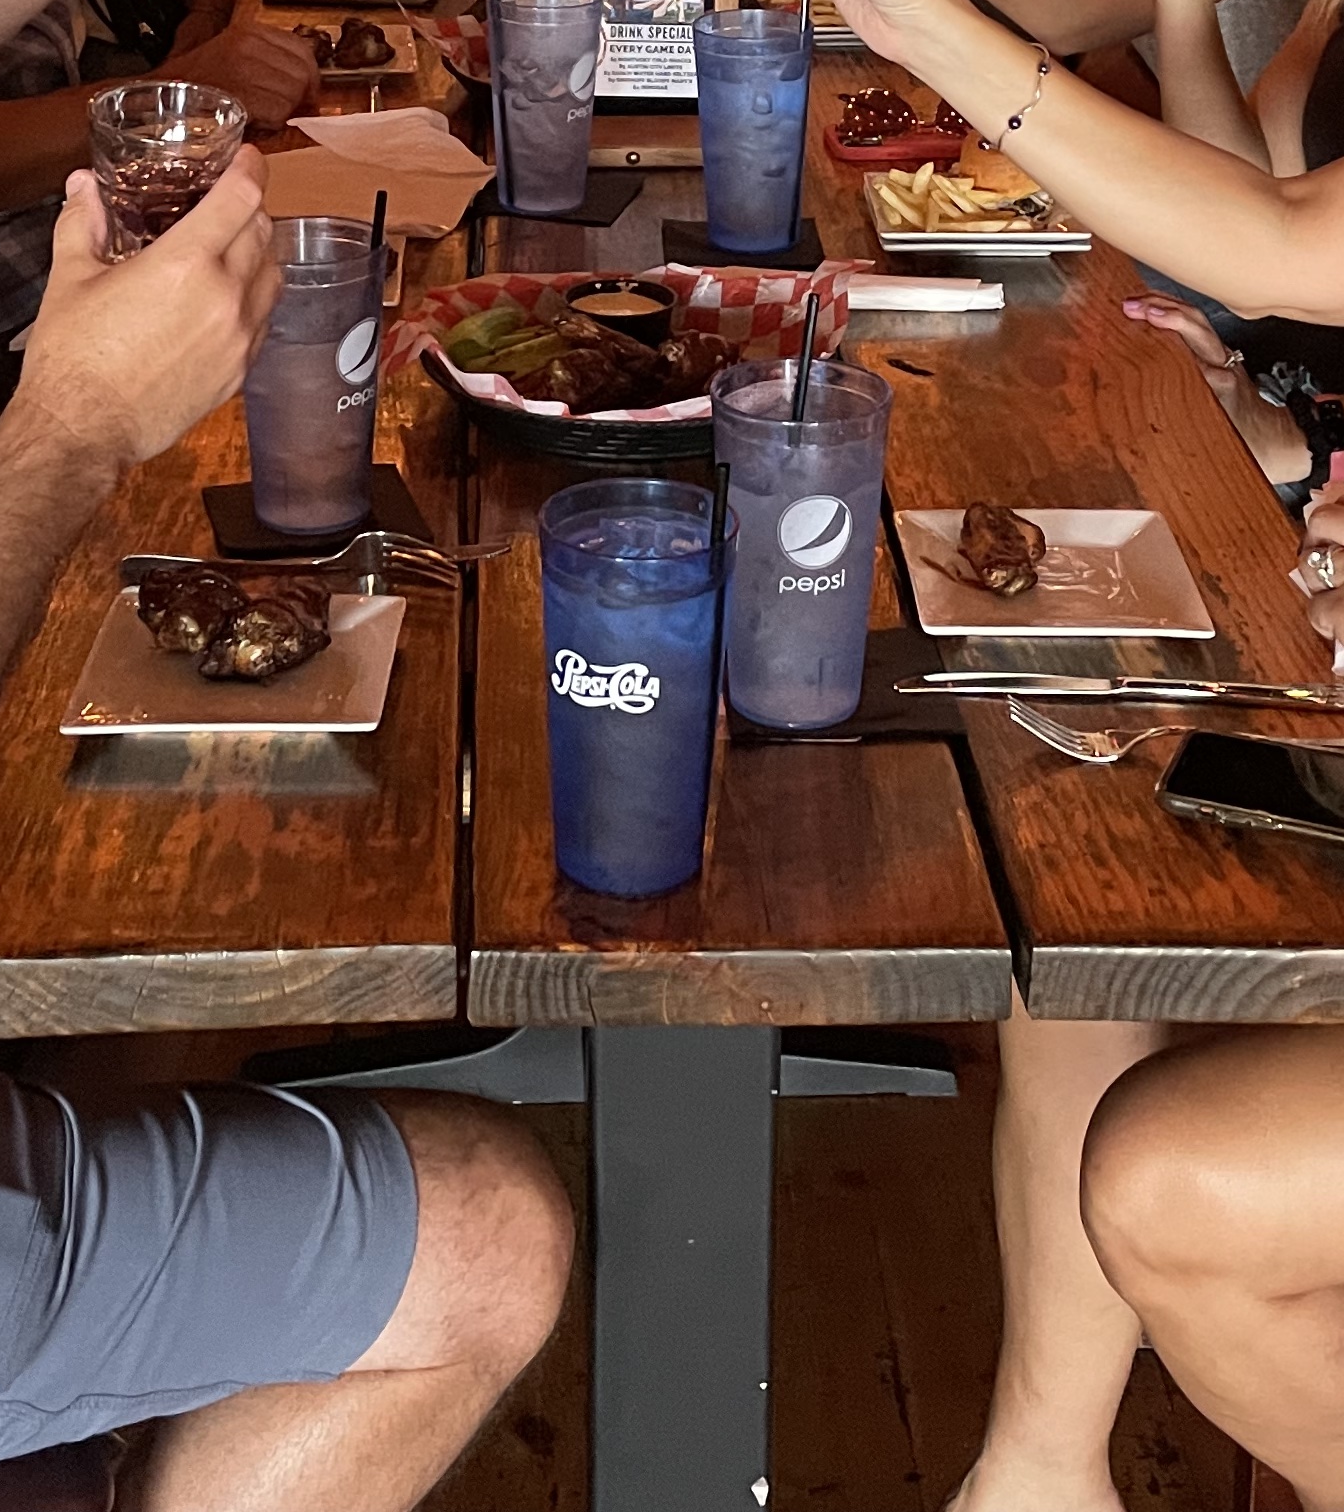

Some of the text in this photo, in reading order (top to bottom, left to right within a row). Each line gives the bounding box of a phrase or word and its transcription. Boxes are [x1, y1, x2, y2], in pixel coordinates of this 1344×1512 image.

[610, 25, 643, 39] DRINK
[609, 44, 694, 54] EVERY GAME DA
[778, 568, 846, 596] pepsi
